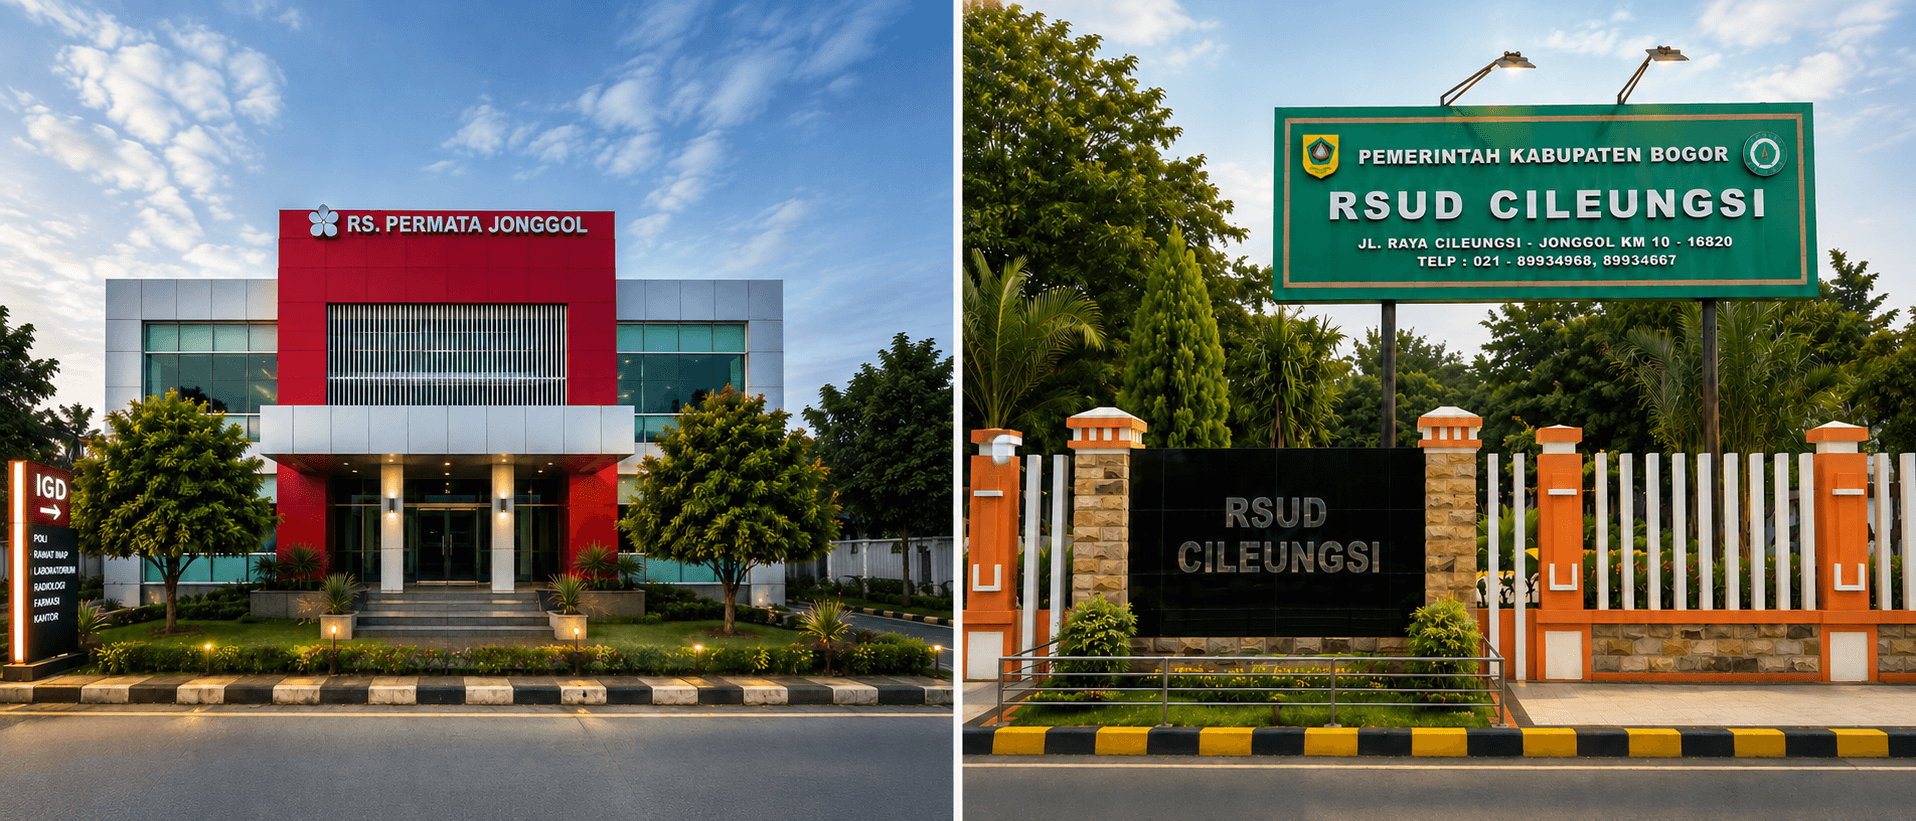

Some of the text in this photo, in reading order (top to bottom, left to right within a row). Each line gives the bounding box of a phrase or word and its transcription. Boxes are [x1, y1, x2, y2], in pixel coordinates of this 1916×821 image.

[1358, 146, 1729, 165] PEMERINTAH KABUPATEN BOGOR
[1329, 188, 1766, 221] RSUD CILEUNGSI
[347, 215, 589, 234] RS. PERMATA JONGGOL
[1358, 238, 1382, 249] JL.
[1387, 238, 1428, 249] RAYA
[1435, 237, 1522, 249] CILEUNGSI
[1538, 237, 1615, 248] JONGGOL
[1621, 236, 1646, 248] KM
[1651, 236, 1671, 248] 10
[1687, 236, 1733, 248] 16820
[1417, 256, 1457, 268] TELP
[1473, 256, 1500, 267] 021
[1516, 255, 1597, 268] 89934968,
[1602, 254, 1677, 266] 89934667
[36, 473, 67, 500] IGD
[1225, 496, 1327, 529] RSUD
[1177, 540, 1380, 574] CILEUNGSI
